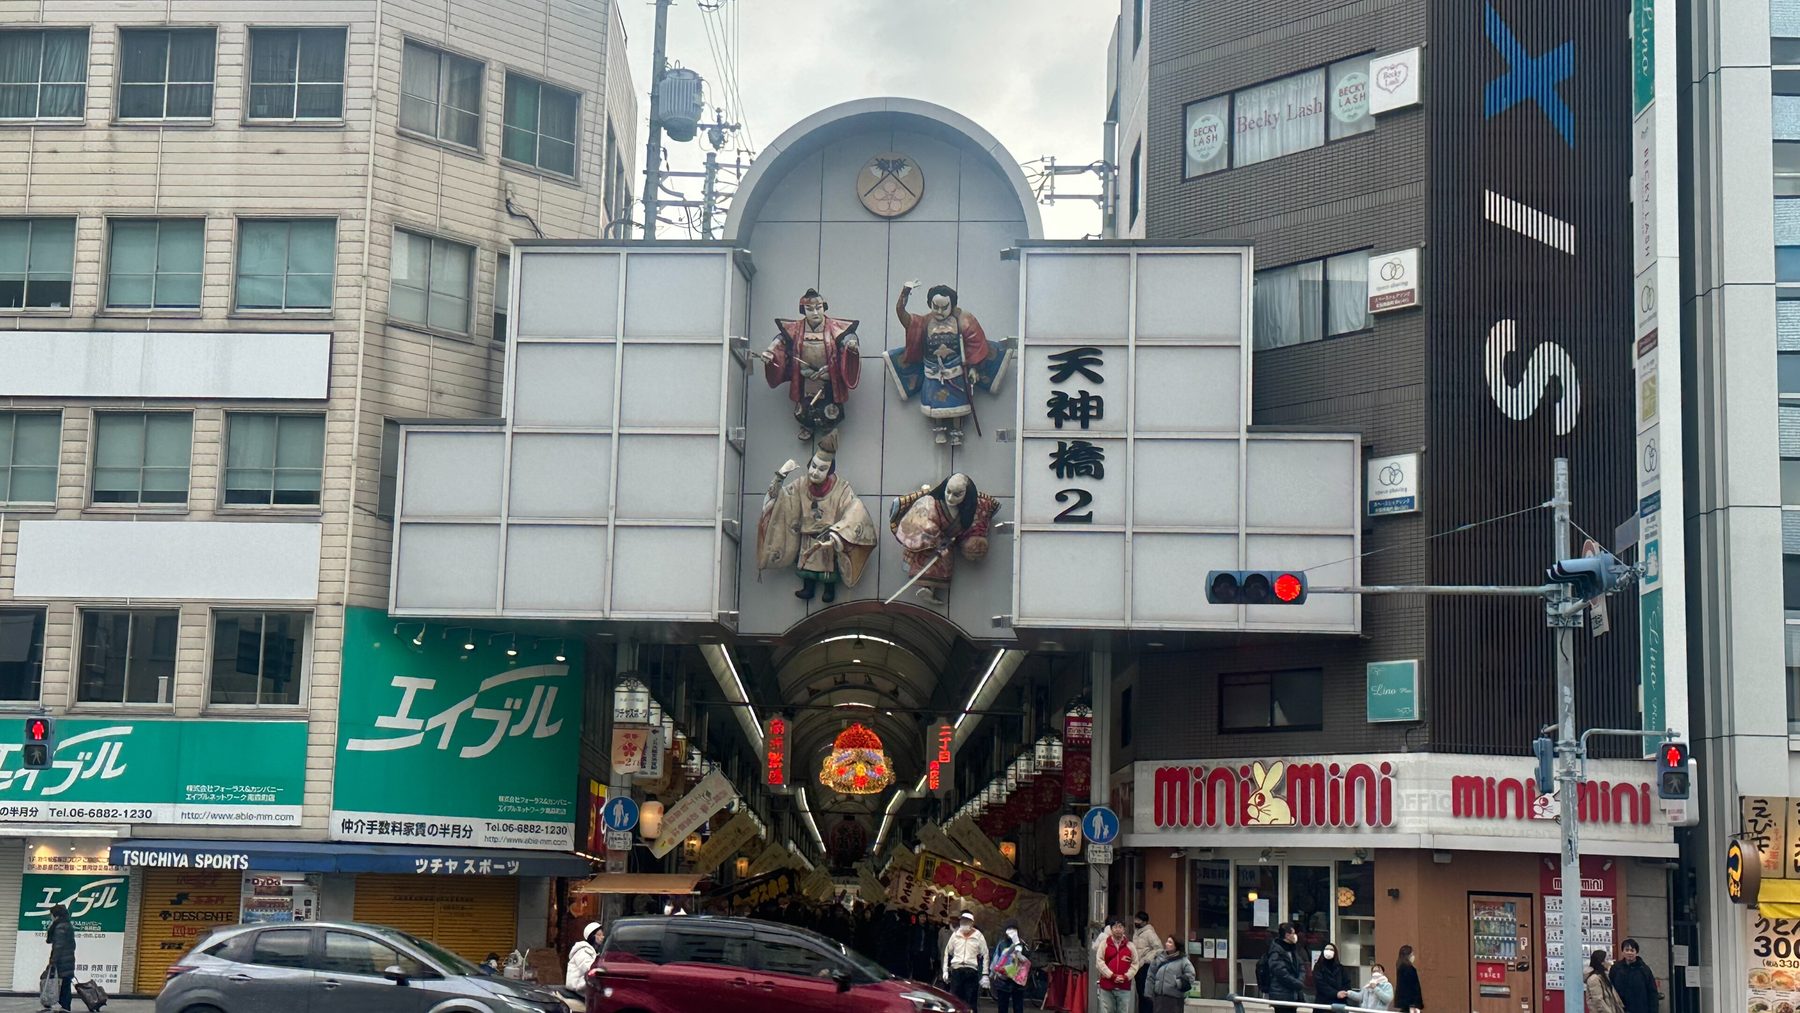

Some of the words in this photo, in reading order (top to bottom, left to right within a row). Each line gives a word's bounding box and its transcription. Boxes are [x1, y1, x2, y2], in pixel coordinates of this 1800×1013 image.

[1338, 81, 1366, 97] BECKY
[1338, 92, 1366, 108] LASH
[1237, 109, 1280, 134] Becky
[1286, 97, 1322, 122] Lash
[1193, 124, 1218, 138] BECKY
[1193, 133, 1217, 147] LASH
[1047, 347, 1105, 523] 天神橋2
[346, 664, 569, 759] エイブル
[1153, 765, 1251, 828] mini
[1286, 761, 1393, 828] mini
[341, 818, 474, 839] 仲介手数料家賃の半月分
[123, 850, 189, 868] TSUCHIYA
[194, 854, 249, 869] SPORTS
[251, 877, 282, 887] DyDo
[173, 911, 233, 922] DESCENTE
